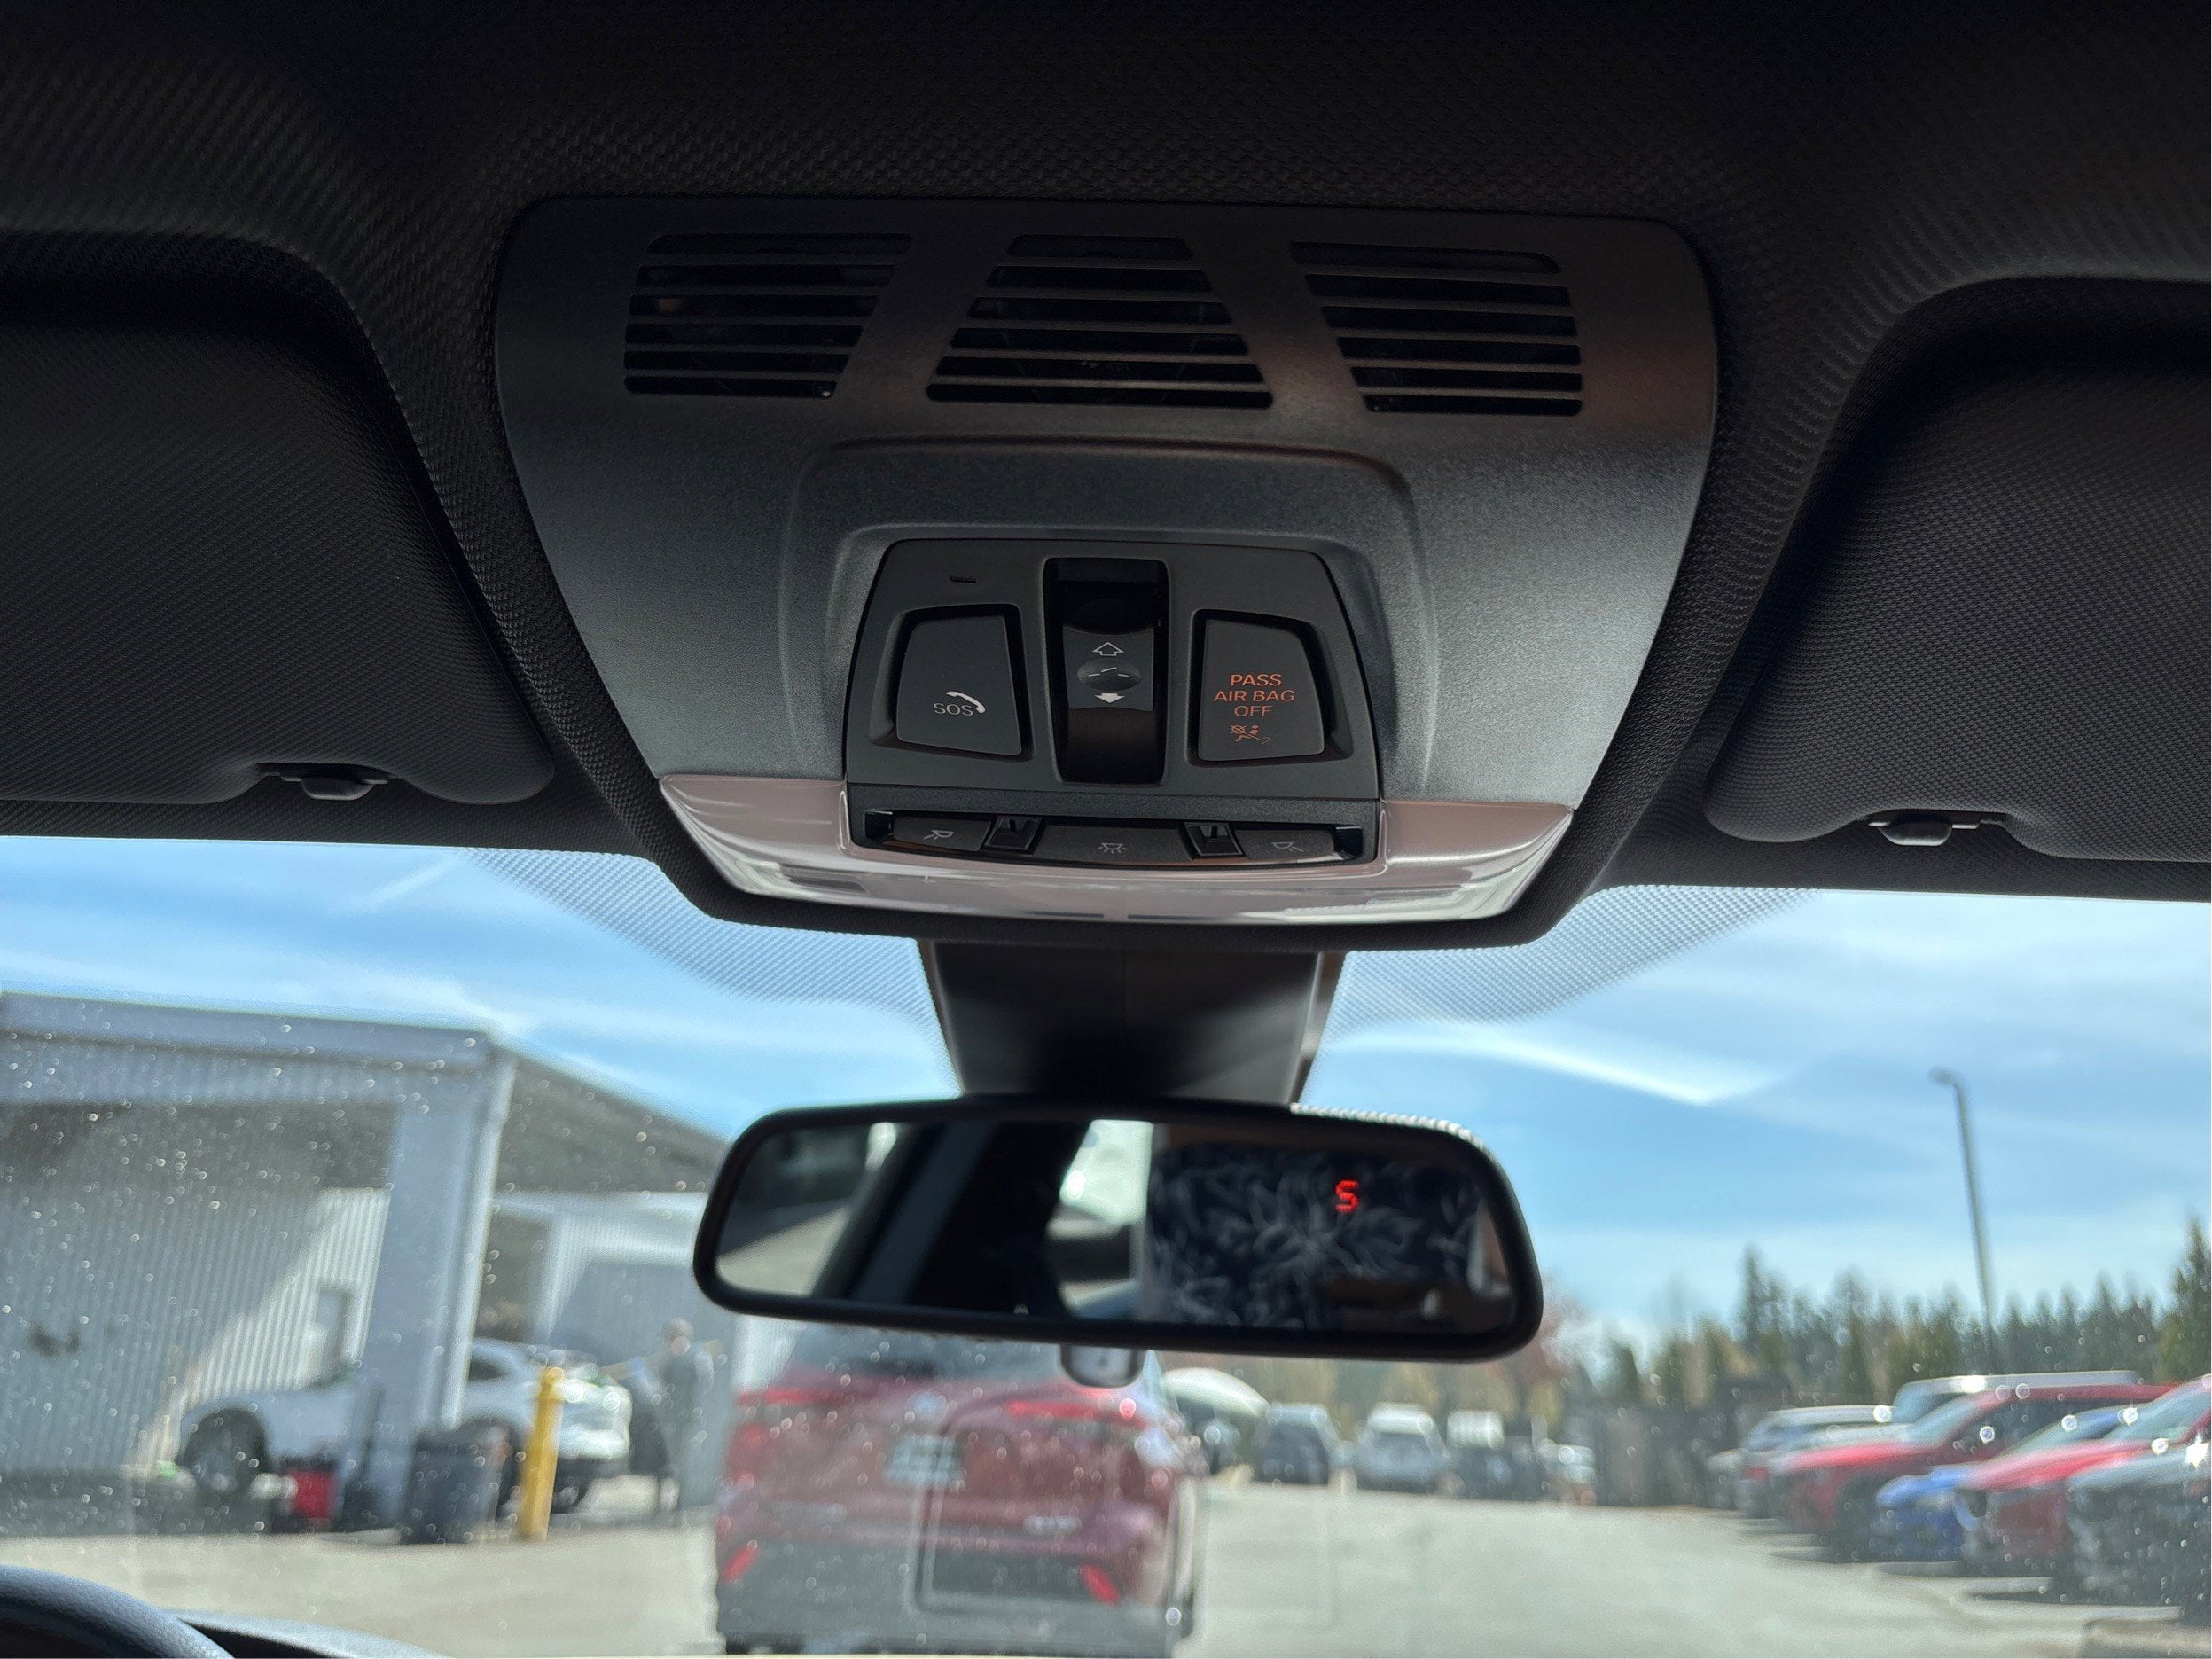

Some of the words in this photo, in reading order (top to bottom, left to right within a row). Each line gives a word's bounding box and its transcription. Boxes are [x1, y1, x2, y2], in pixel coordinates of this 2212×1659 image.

[1231, 674, 1282, 686] PASS
[1214, 691, 1247, 701] AIR
[1253, 690, 1294, 702] BAG
[934, 702, 973, 716] SOS
[1234, 705, 1273, 717] OFF
